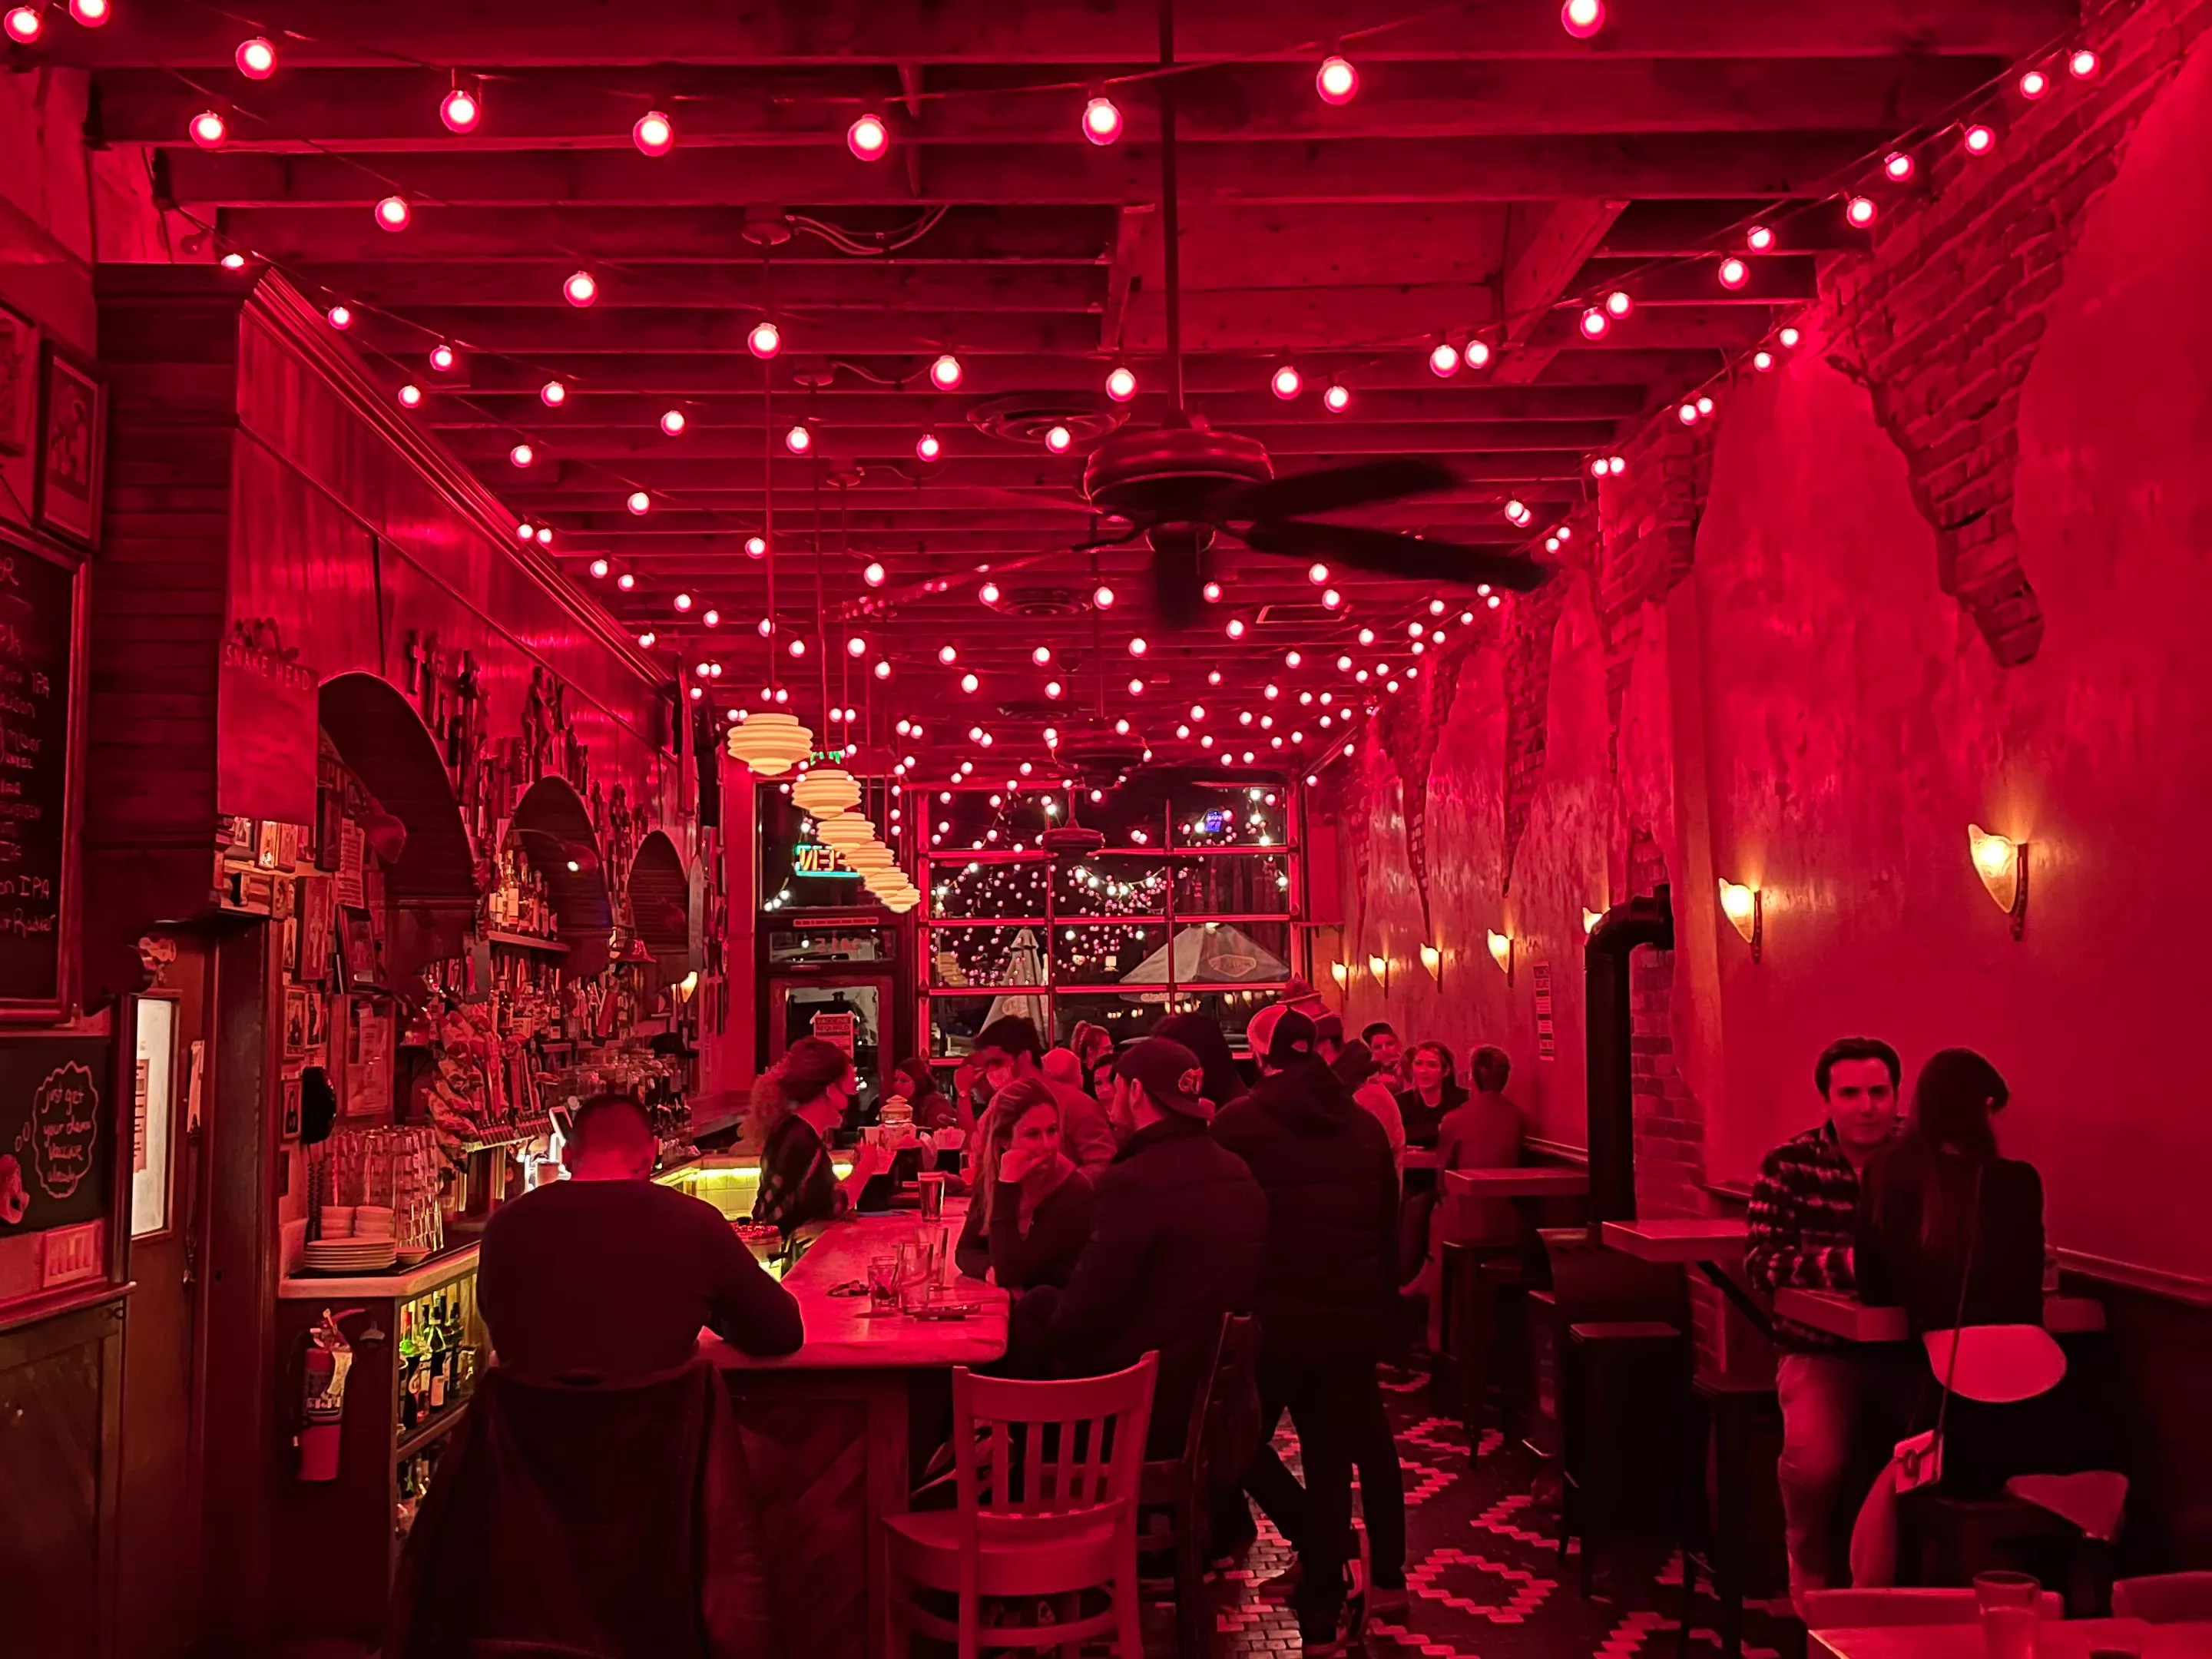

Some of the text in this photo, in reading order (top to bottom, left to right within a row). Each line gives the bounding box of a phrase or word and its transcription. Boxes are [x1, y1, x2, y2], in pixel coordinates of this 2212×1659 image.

[224, 644, 310, 690] SNAKE HEAD
[18, 875, 50, 899] IPA
